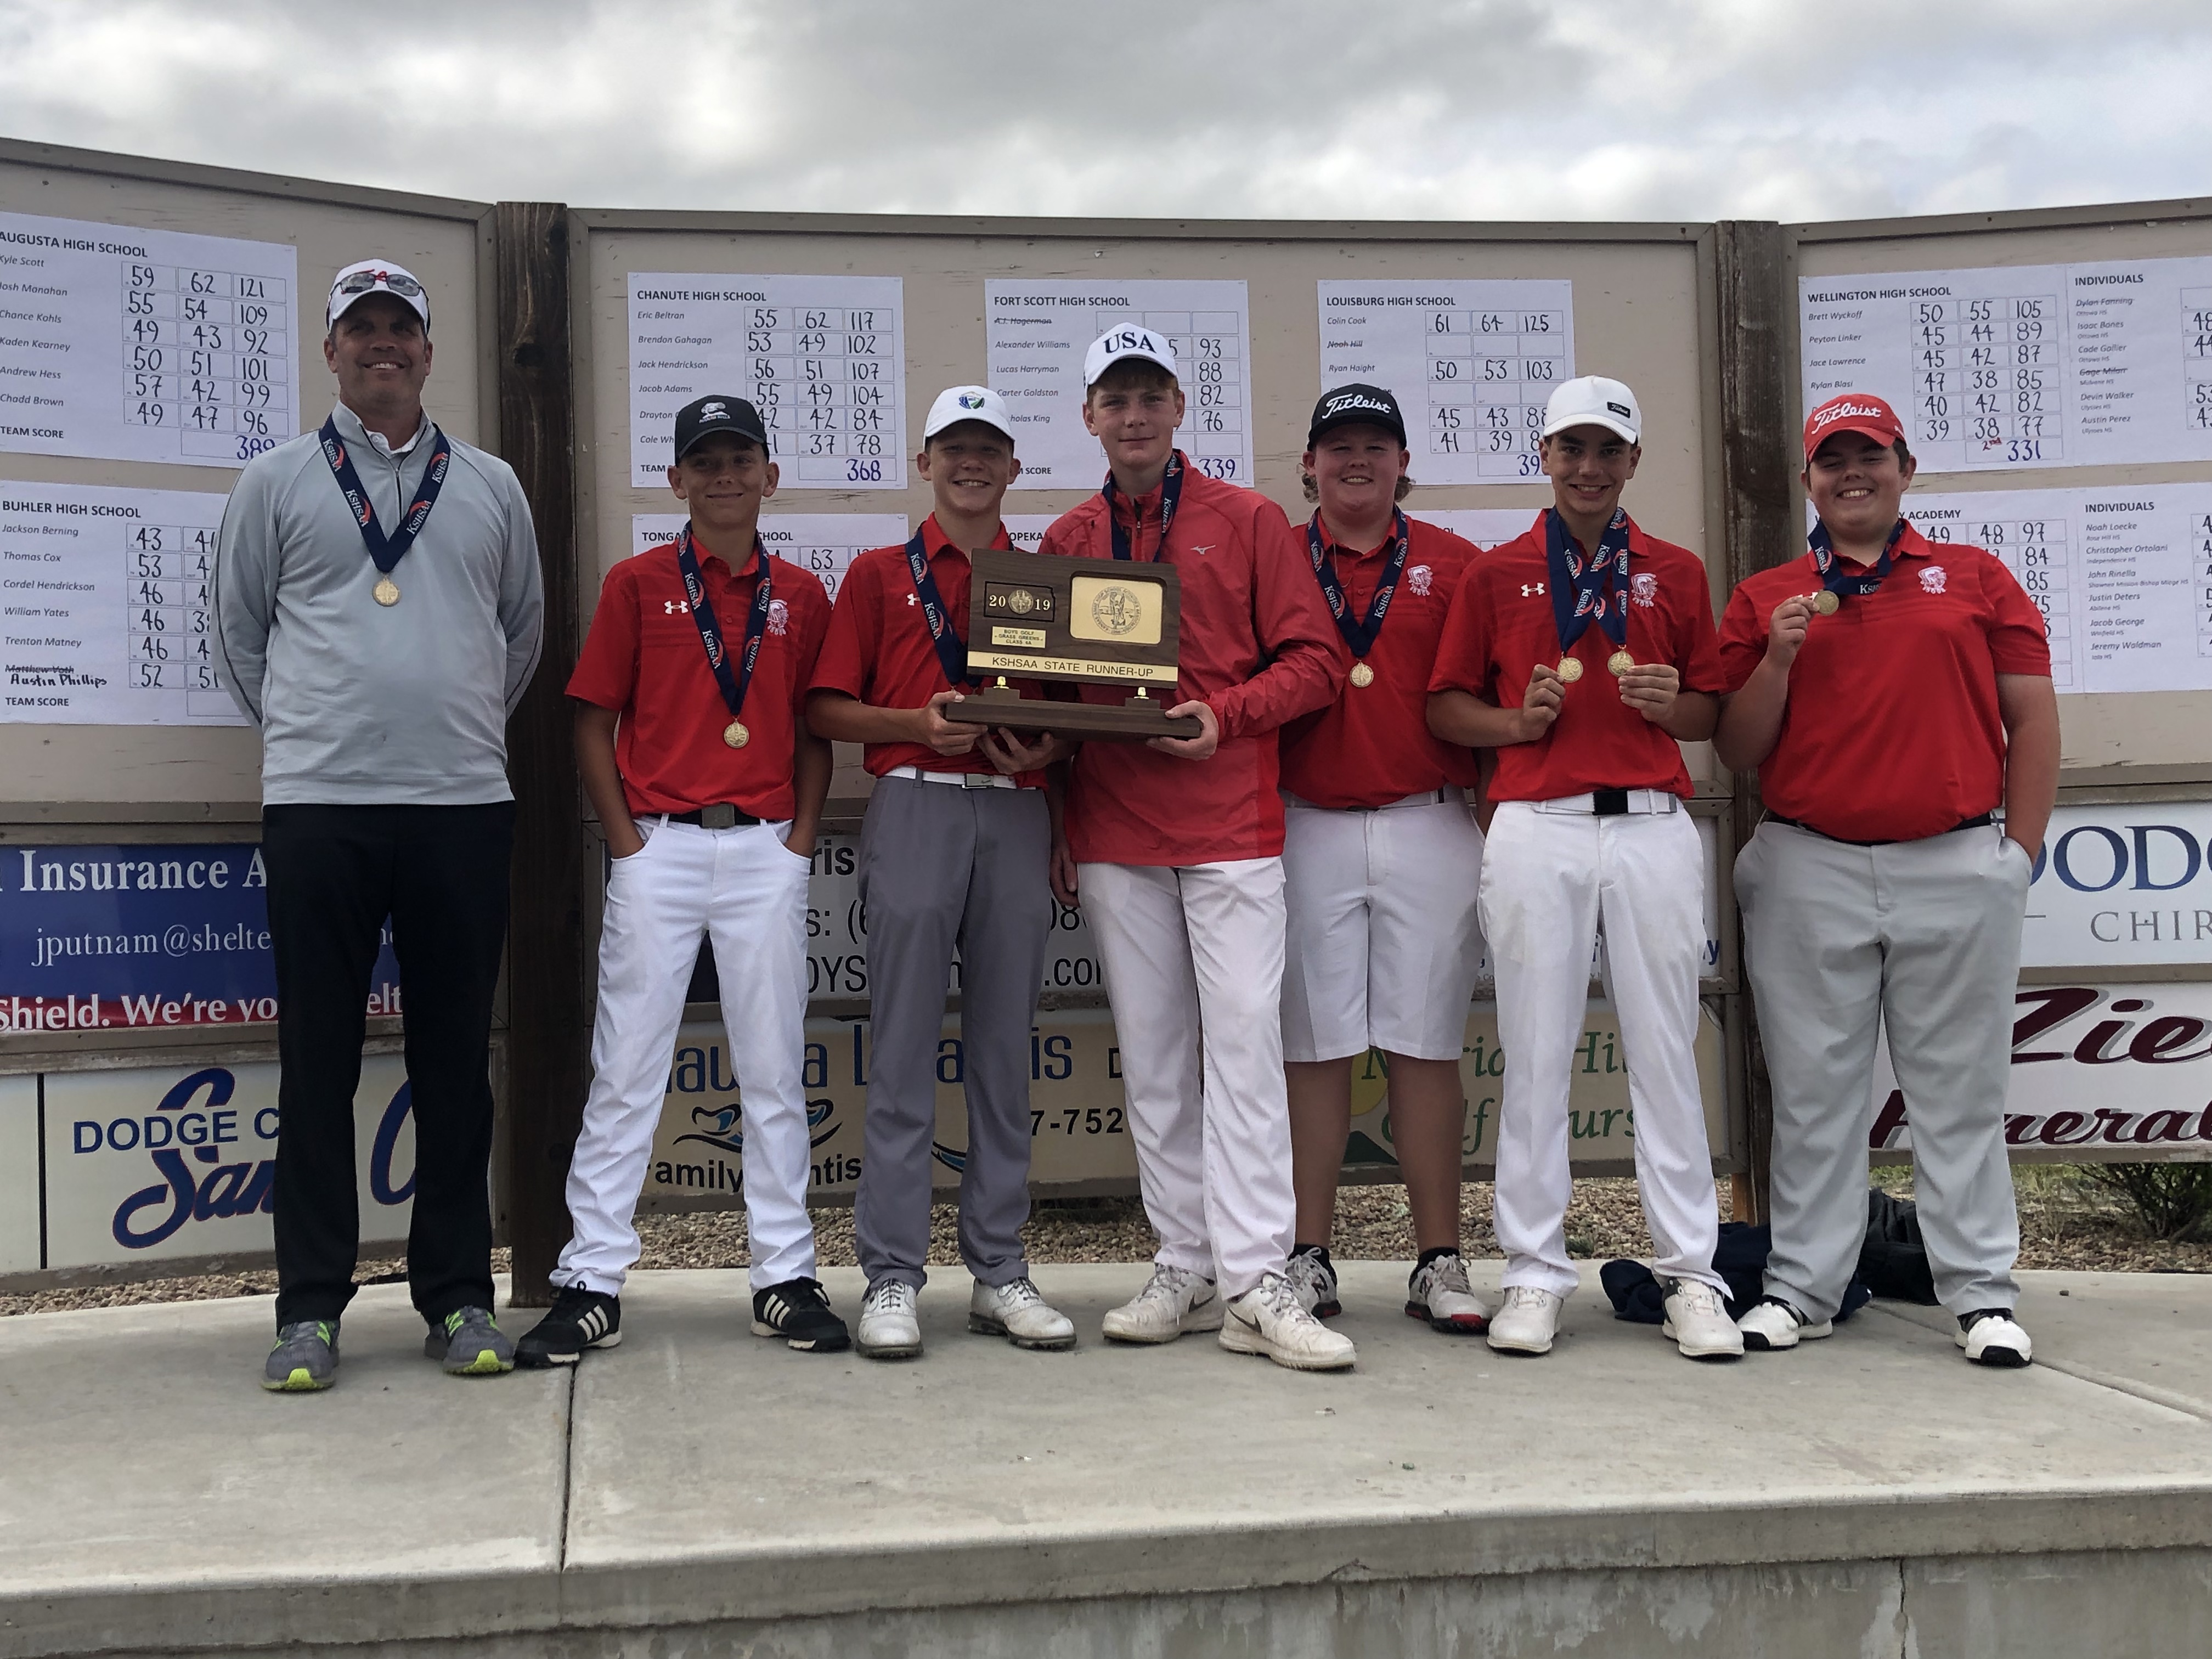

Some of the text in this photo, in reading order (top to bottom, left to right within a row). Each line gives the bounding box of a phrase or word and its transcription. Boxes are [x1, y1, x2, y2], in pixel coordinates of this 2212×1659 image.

[0, 231, 148, 257] AUGUSTA HIGH SCHOOL
[131, 266, 264, 298] 59 62 121
[2075, 274, 2143, 286] INDIVIDUALS
[637, 290, 767, 302] CHANUTE HIGH SCHOOL
[994, 296, 1130, 306] FORT SCOTT HIGH SCHOOL
[1327, 297, 1456, 306] LOUISBURG HIGH SCHOOL
[1808, 286, 1951, 303] WELLINGTON HIGH SCHOOL
[0, 310, 61, 323] Chance Kohls
[637, 311, 684, 320] Eric Beltran
[1435, 314, 1549, 332] 61 64 125
[1808, 310, 1863, 321] Brett Wyckoff
[0, 336, 70, 352] Kaden Kearney
[638, 336, 672, 345] Brendon
[748, 332, 876, 354] 53 49 102
[1103, 332, 1156, 353] USA
[1809, 334, 1861, 344] Peyton Linker
[1922, 322, 2042, 346] 45 44 89
[1200, 338, 1222, 358] 93
[1923, 345, 2040, 368] 45 42 87
[638, 360, 708, 369] Jack Hendrickson
[755, 359, 879, 380] 56 51 107
[996, 365, 1059, 374] Lucas Harryman
[1199, 362, 1222, 382] 88
[1329, 364, 1375, 374] Ryan Haight
[1435, 360, 1553, 380] 50 53 103
[1809, 357, 1866, 367] Jace Lawrence
[136, 374, 270, 407] 57 42 99
[1925, 370, 2042, 392] 47 38 85
[0, 393, 64, 407] Chadd Brown
[757, 383, 884, 405] 55 49 104
[1322, 393, 1391, 419] Titleist
[137, 402, 268, 435] 49 47 96
[1034, 415, 1050, 424] King
[1437, 408, 1509, 428] 45 43
[1812, 403, 1881, 435] Titleist
[1927, 416, 2044, 440] 39 38 77
[1, 426, 64, 438] TEAM SCORE
[640, 436, 657, 444] Cole
[323, 438, 342, 471] KSHSAA
[810, 435, 881, 455] 37 78
[2007, 440, 2041, 461] 331
[641, 464, 665, 472] TEAM
[846, 459, 881, 481] 368
[2, 500, 141, 518] BUHLER HIGH SCHOOL
[346, 489, 369, 527] KSHSAA
[406, 500, 432, 534] KSHSAA
[1908, 510, 1961, 520] ACADEMY
[2085, 501, 2154, 513] INDIVIDUALS
[2, 524, 78, 537] Jackson Berning
[136, 527, 162, 550] 43
[1008, 532, 1042, 541] OPEKA
[4, 551, 61, 562] Thomas Cox
[811, 549, 833, 569] 63
[1590, 544, 1610, 572] KSHSAA
[2025, 546, 2050, 566] 84
[139, 555, 162, 578] 53
[4, 579, 95, 591] Cordel Hendrickson
[2027, 570, 2050, 590] 85
[140, 582, 163, 604] 46
[685, 572, 701, 611] KSHSAA
[1374, 585, 1394, 618] KSHSAA
[2089, 592, 2140, 602] Justin Deters
[989, 595, 1050, 610] 20 19
[1324, 585, 1343, 619] KSHSAA
[142, 609, 165, 631] 46
[925, 602, 941, 640] KSHSAA
[5, 637, 82, 648] Trenton Matney
[702, 629, 721, 669] KSHSAA
[746, 635, 760, 672] KSHSAA
[141, 664, 163, 687] 52
[992, 657, 1154, 677] KSHSAA STATE RUNNER-UP
[10, 674, 107, 687] Austin Phillips
[19, 849, 229, 893] Insurance
[31, 923, 273, 967] jputnam@shelte
[0, 994, 278, 1030] Shield. We're yo
[74, 1110, 238, 1154] DODGE
[651, 1158, 743, 1192] amily
